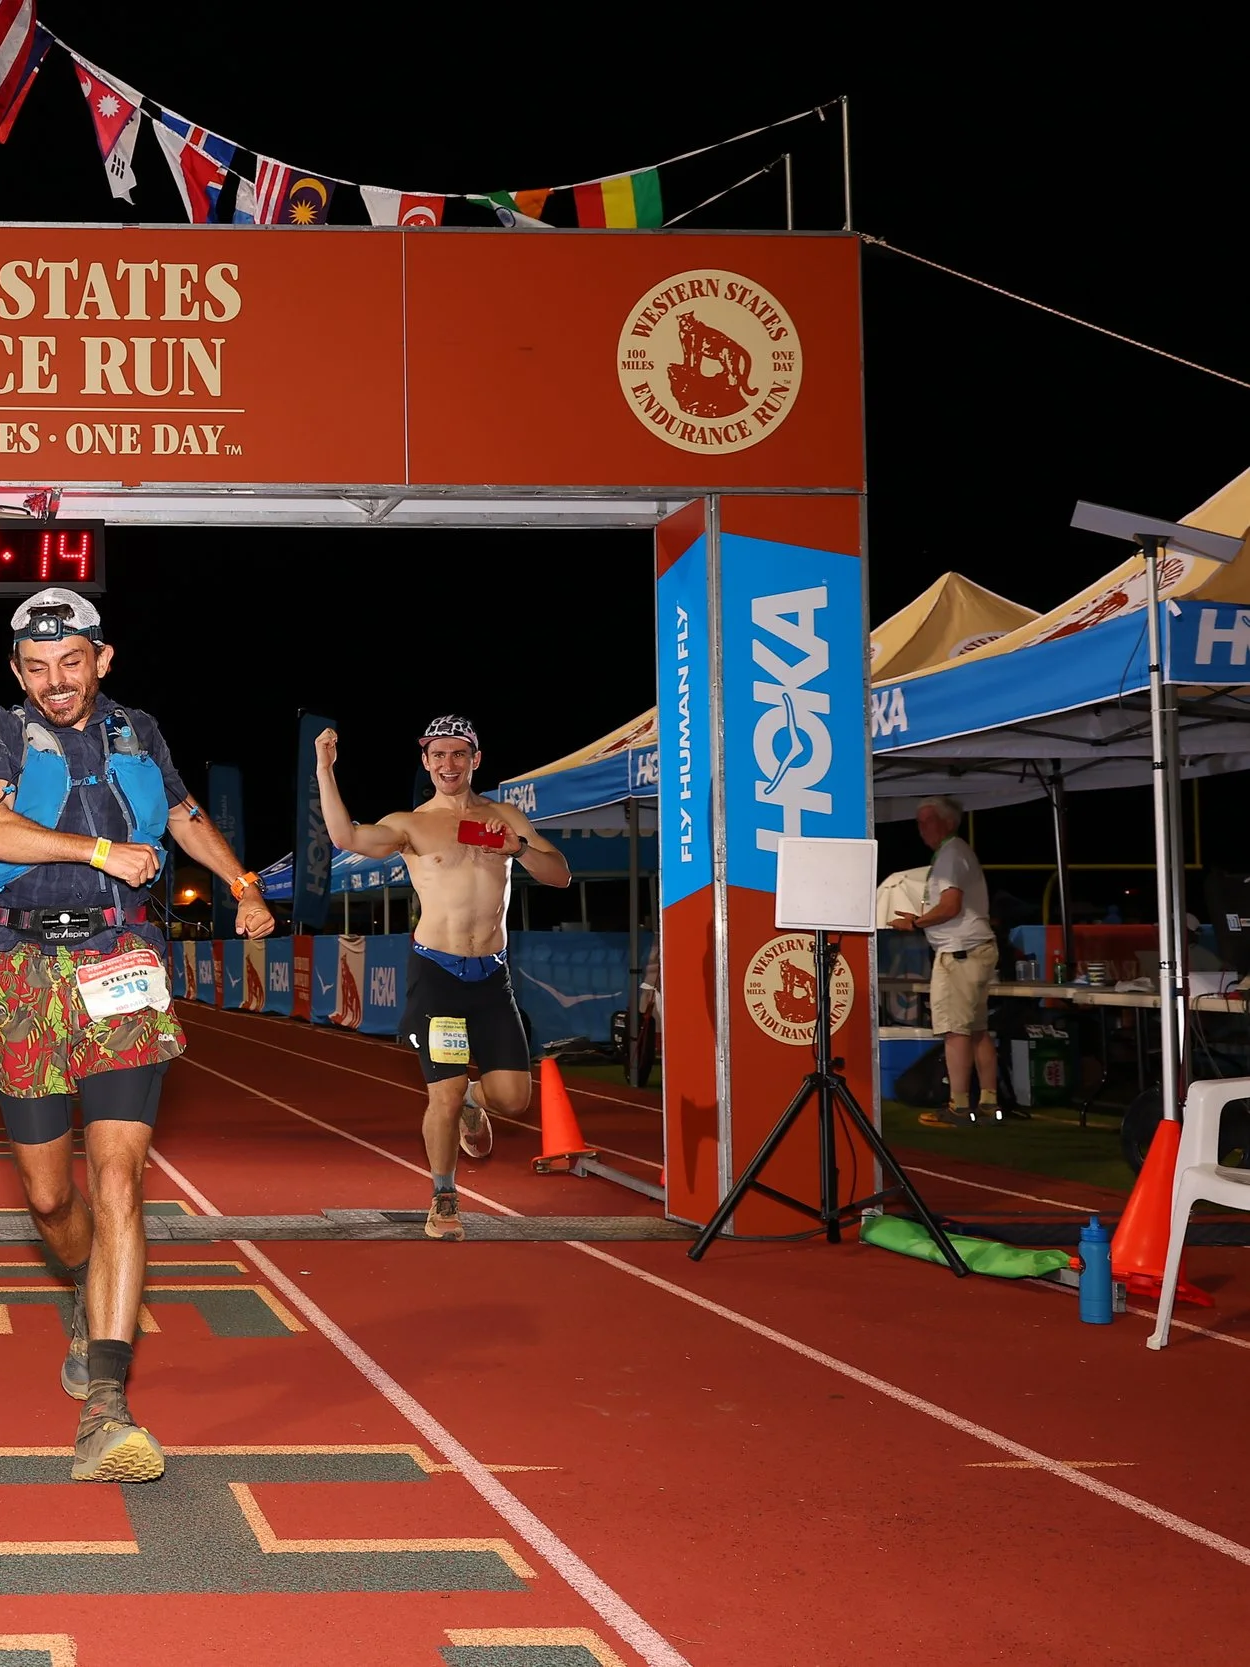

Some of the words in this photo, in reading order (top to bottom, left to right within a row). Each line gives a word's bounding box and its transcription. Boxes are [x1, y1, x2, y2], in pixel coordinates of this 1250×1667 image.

[631, 278, 720, 340] WESTERN
[724, 282, 789, 342] STATES
[81, 335, 227, 398] RUN
[621, 360, 655, 371] MILES
[626, 349, 647, 359] 100
[772, 351, 795, 361] ONE
[773, 362, 794, 372] DAY
[631, 381, 753, 445] ENDURANCE
[752, 380, 791, 428] RUN
[66, 423, 142, 456] ONE
[152, 424, 226, 457] DAY
[676, 606, 689, 661] FLY
[751, 585, 833, 853] HOKA
[871, 687, 909, 738] KA
[677, 665, 691, 800] HUMAN
[636, 750, 659, 786] HO
[680, 807, 693, 863] FLY
[752, 938, 805, 976] WESTERN
[102, 969, 148, 987] STEFAN
[269, 962, 290, 992] HOKA
[371, 967, 397, 1007] HOKA
[752, 1001, 817, 1040] ENDURANC
[443, 1039, 467, 1048] 318
